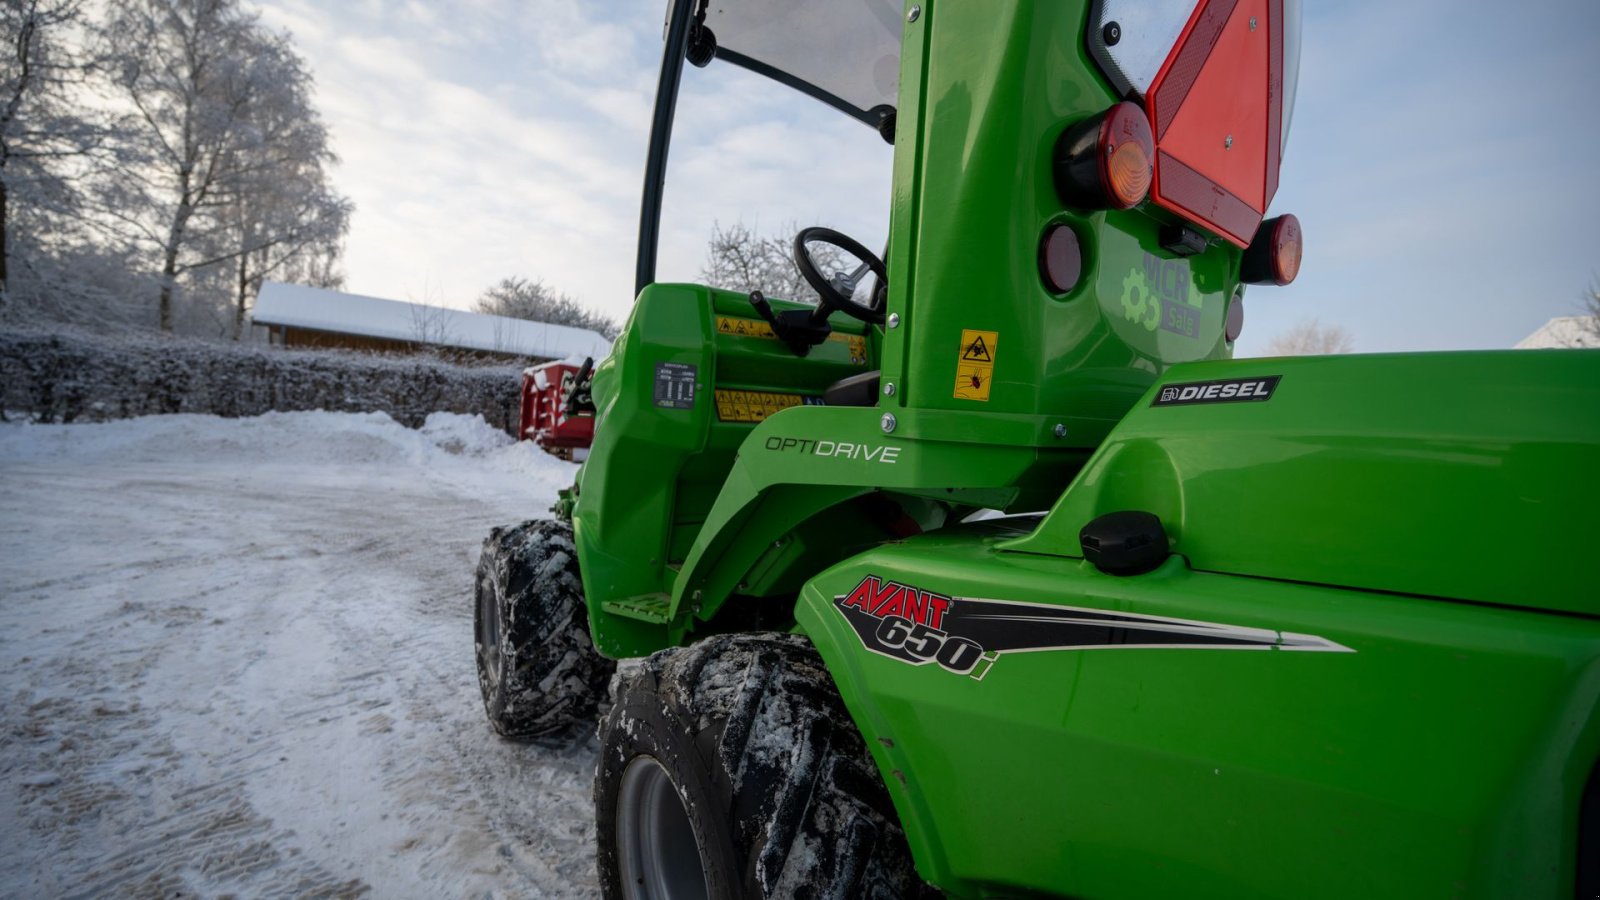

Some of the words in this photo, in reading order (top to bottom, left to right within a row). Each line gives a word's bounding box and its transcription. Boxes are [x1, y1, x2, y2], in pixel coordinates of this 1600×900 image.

[1178, 381, 1270, 400] DIESEL
[765, 436, 902, 463] OPTIDRIVE
[841, 576, 951, 631] AVANT
[876, 615, 1000, 681] 650i
